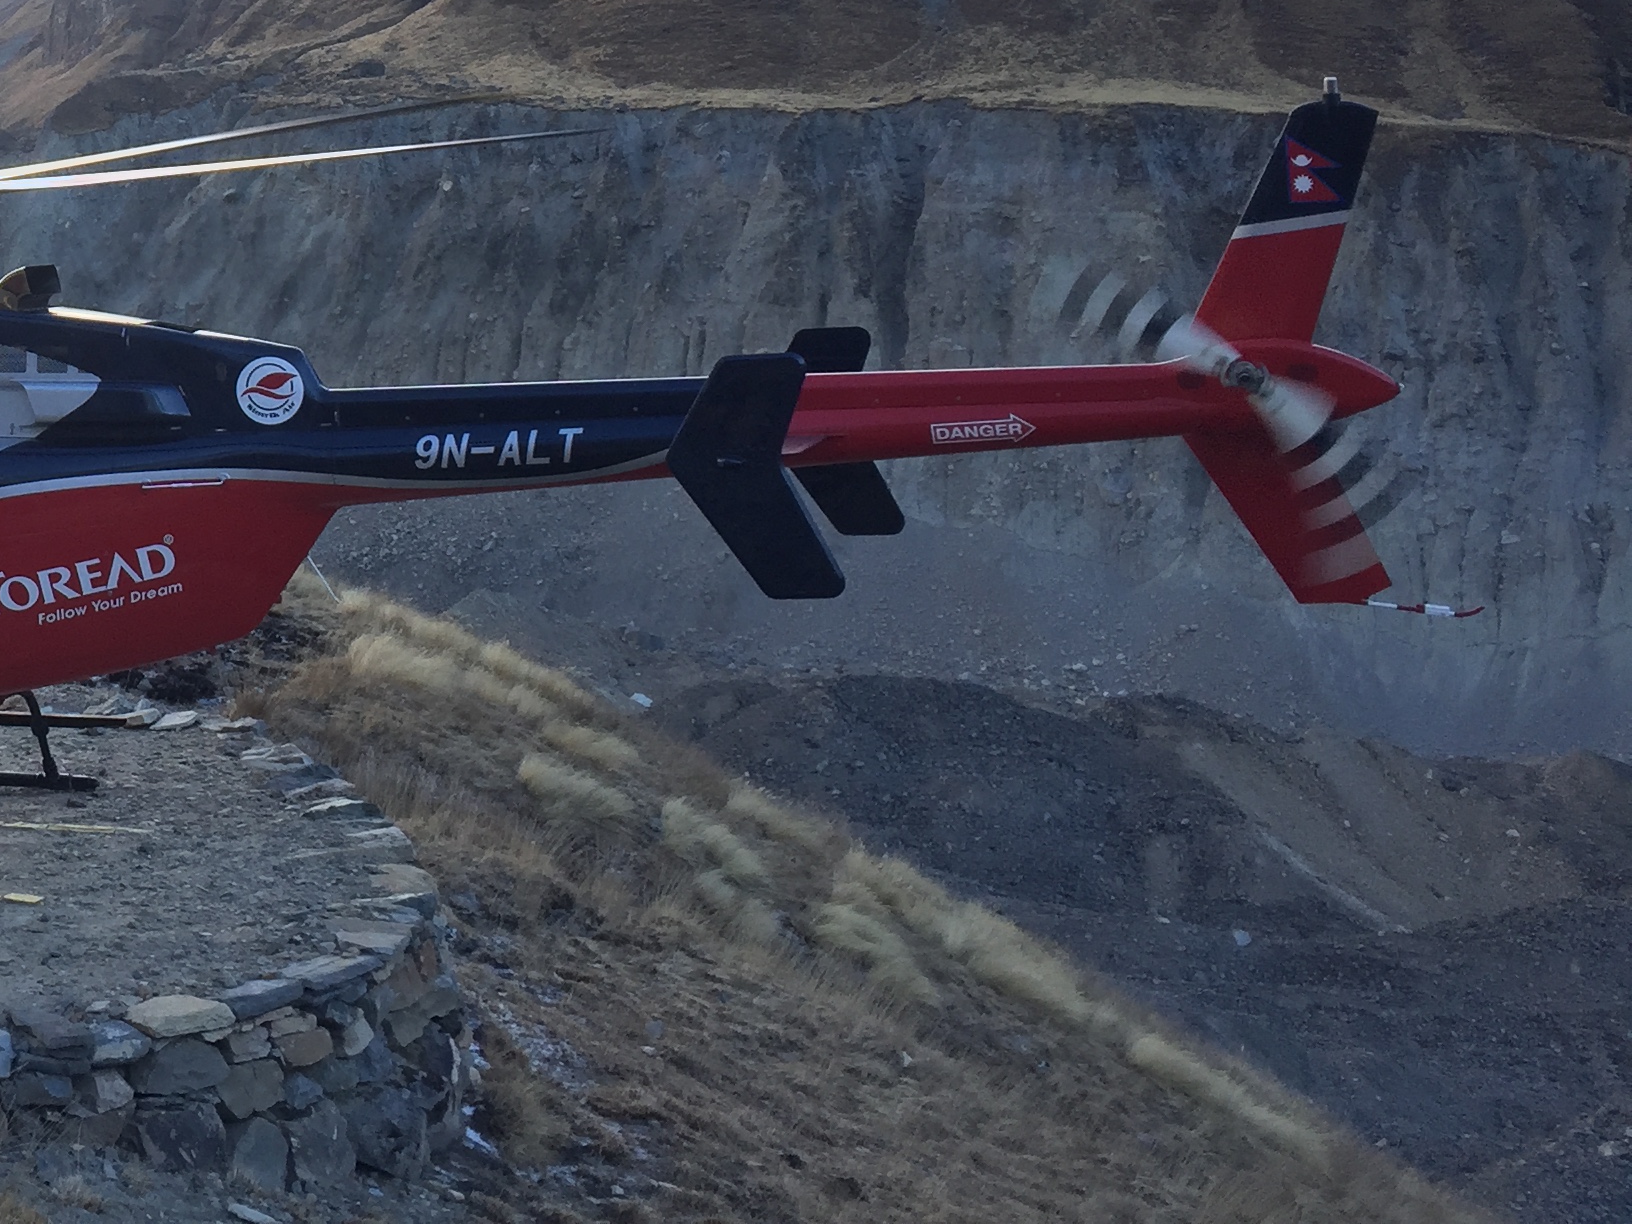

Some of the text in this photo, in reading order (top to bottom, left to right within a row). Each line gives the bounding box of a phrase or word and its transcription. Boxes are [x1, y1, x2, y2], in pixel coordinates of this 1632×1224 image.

[414, 427, 584, 469] 9N-ALT
[935, 423, 1022, 440] DANGER
[38, 583, 183, 625] Follow Your Dream
